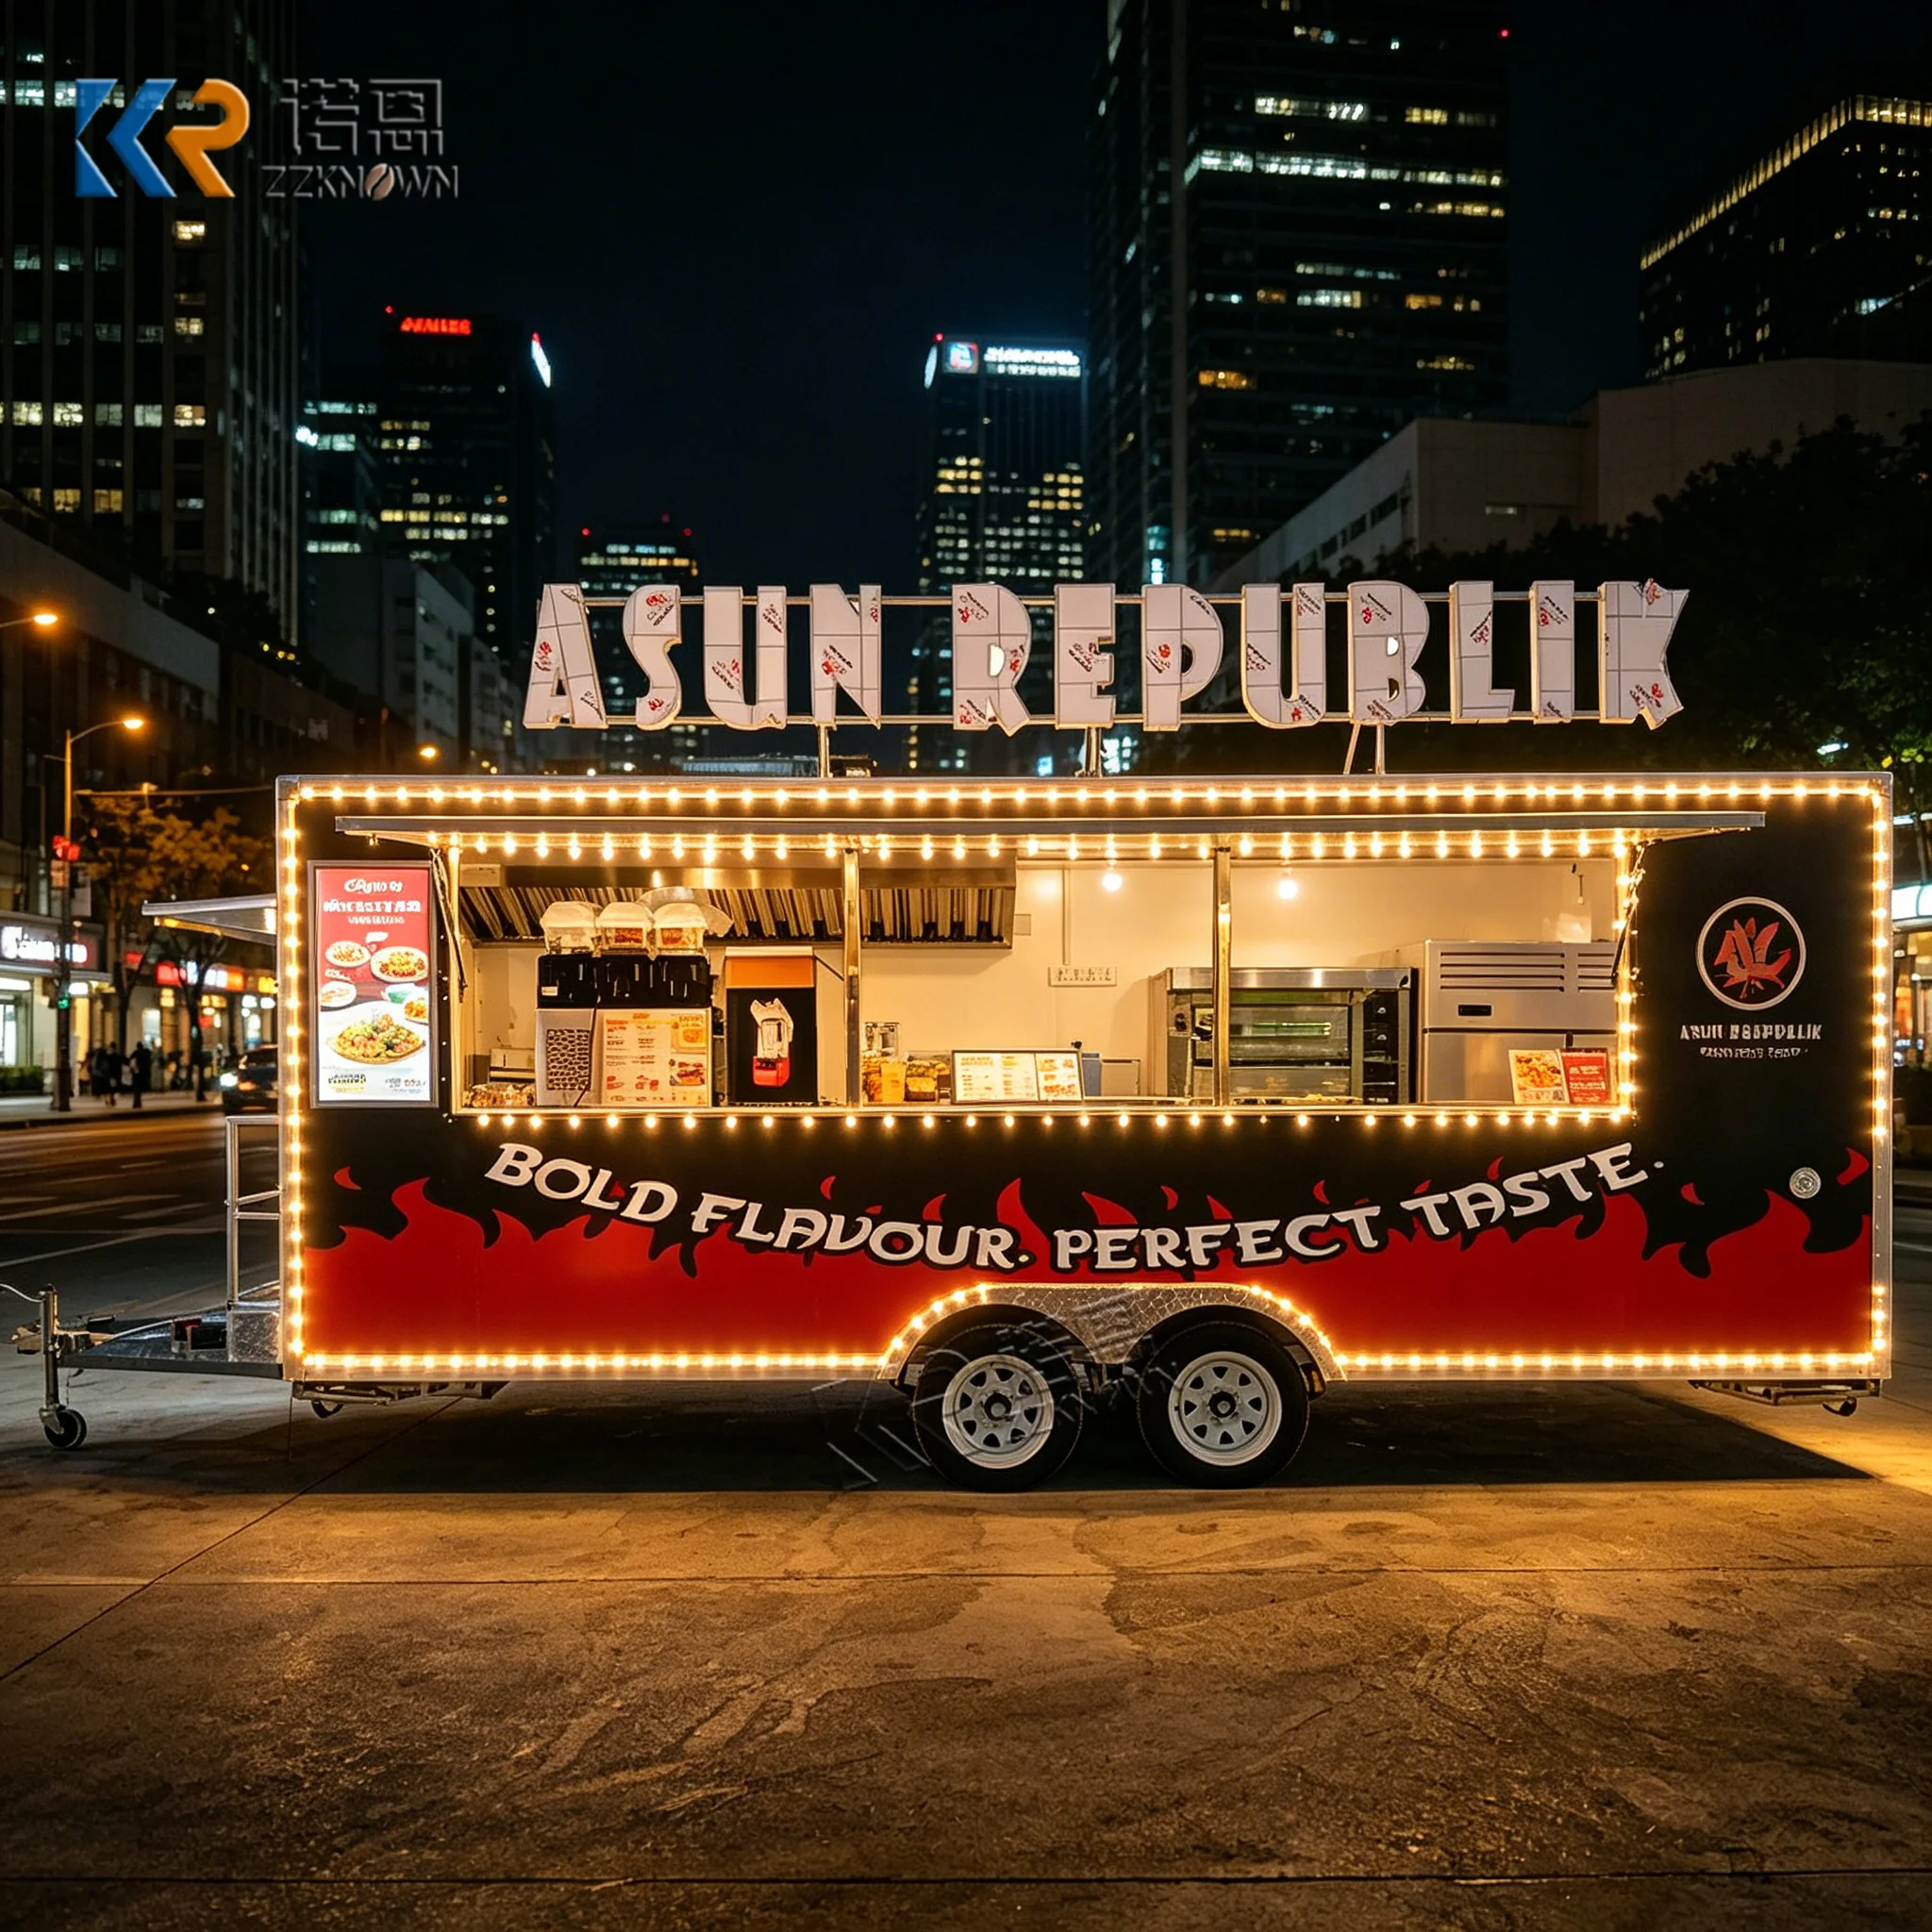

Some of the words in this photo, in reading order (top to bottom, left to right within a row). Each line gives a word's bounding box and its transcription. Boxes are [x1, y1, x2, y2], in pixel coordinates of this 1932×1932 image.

[524, 582, 883, 730] ASUN
[952, 577, 1690, 737] REPUBLIK
[484, 1142, 678, 1223] BOLD
[691, 1191, 1037, 1270] FLAVOUR.
[1054, 1206, 1382, 1270] PERFECT
